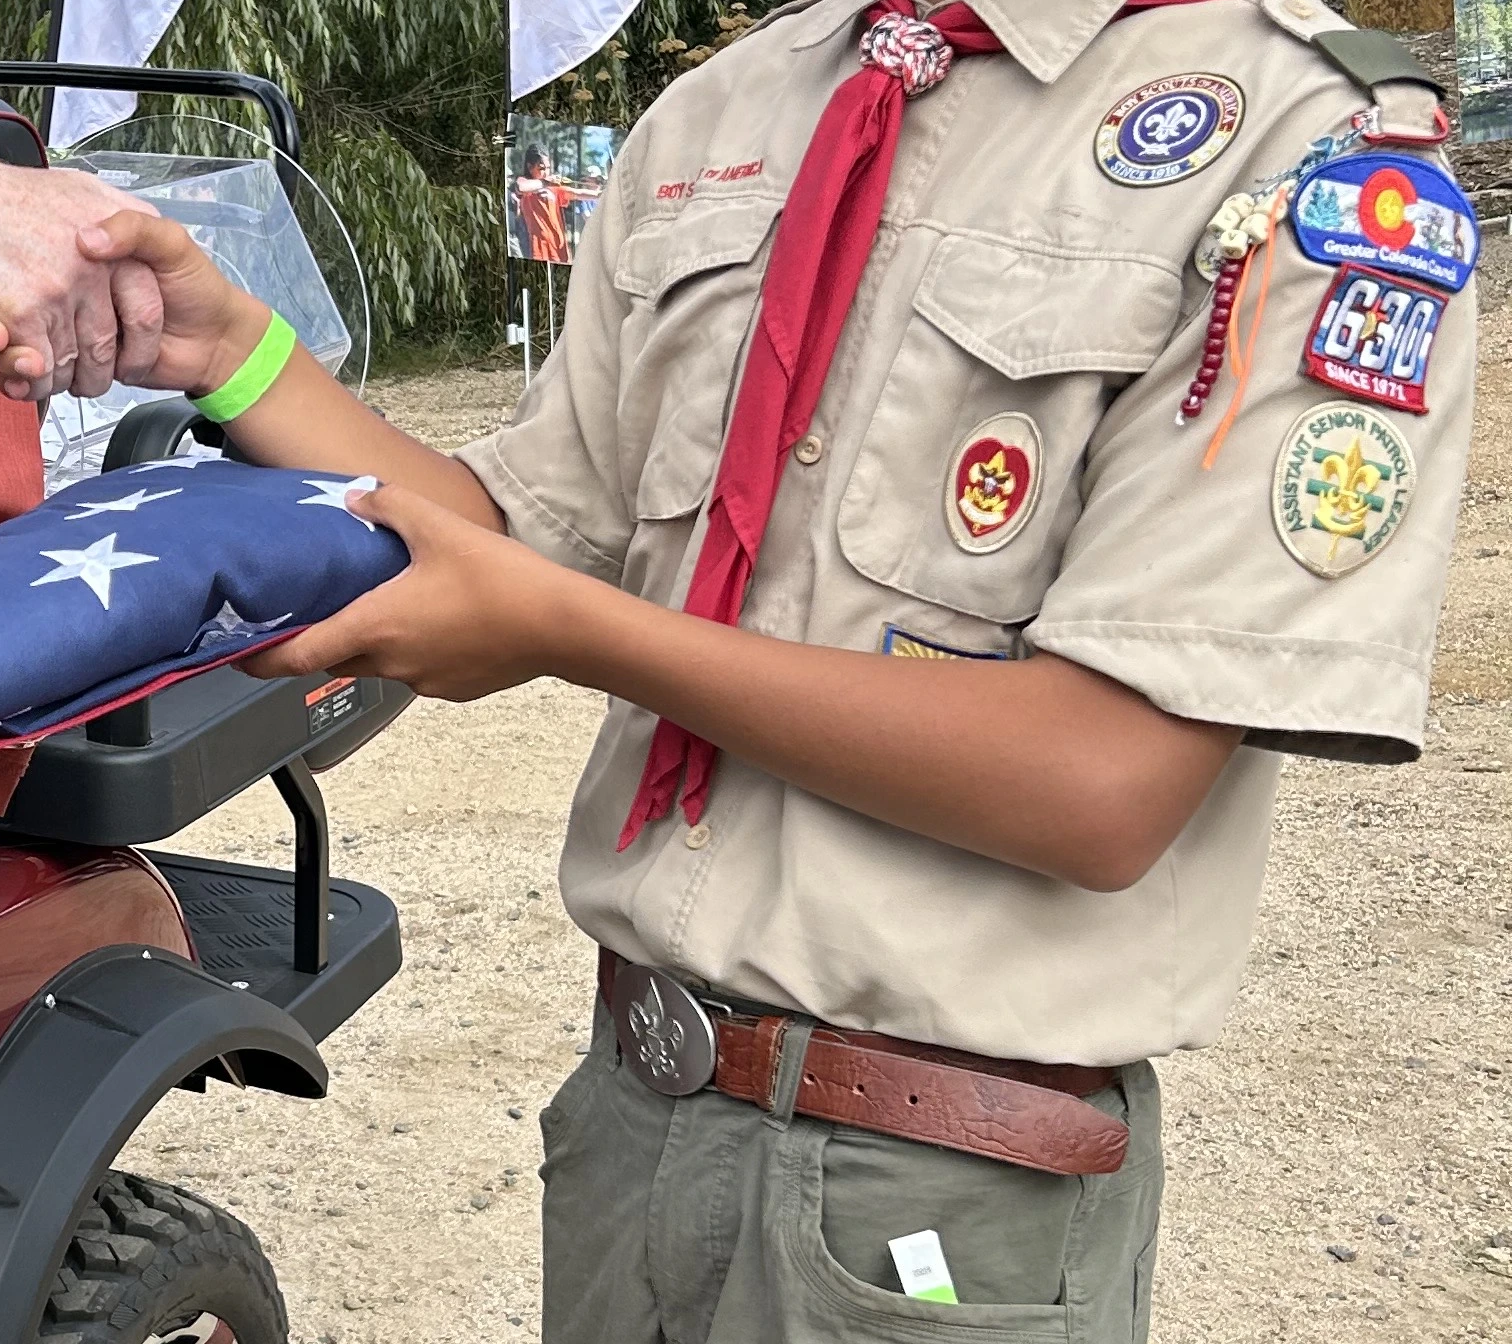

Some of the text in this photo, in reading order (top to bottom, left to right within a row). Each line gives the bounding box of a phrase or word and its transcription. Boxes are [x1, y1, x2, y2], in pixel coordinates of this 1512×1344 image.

[1113, 93, 1140, 117] BOY
[1139, 77, 1198, 101] SCOUTS
[1208, 82, 1239, 124] AMERICA
[1110, 160, 1181, 181] SINCE 1910
[1324, 239, 1378, 258] Greater
[1378, 246, 1428, 270] Colorado
[1324, 278, 1435, 379] 630
[1324, 360, 1407, 401] SINCE 1971
[1283, 411, 1409, 554] ASSISTANT SENIOR PATROL LEADER
